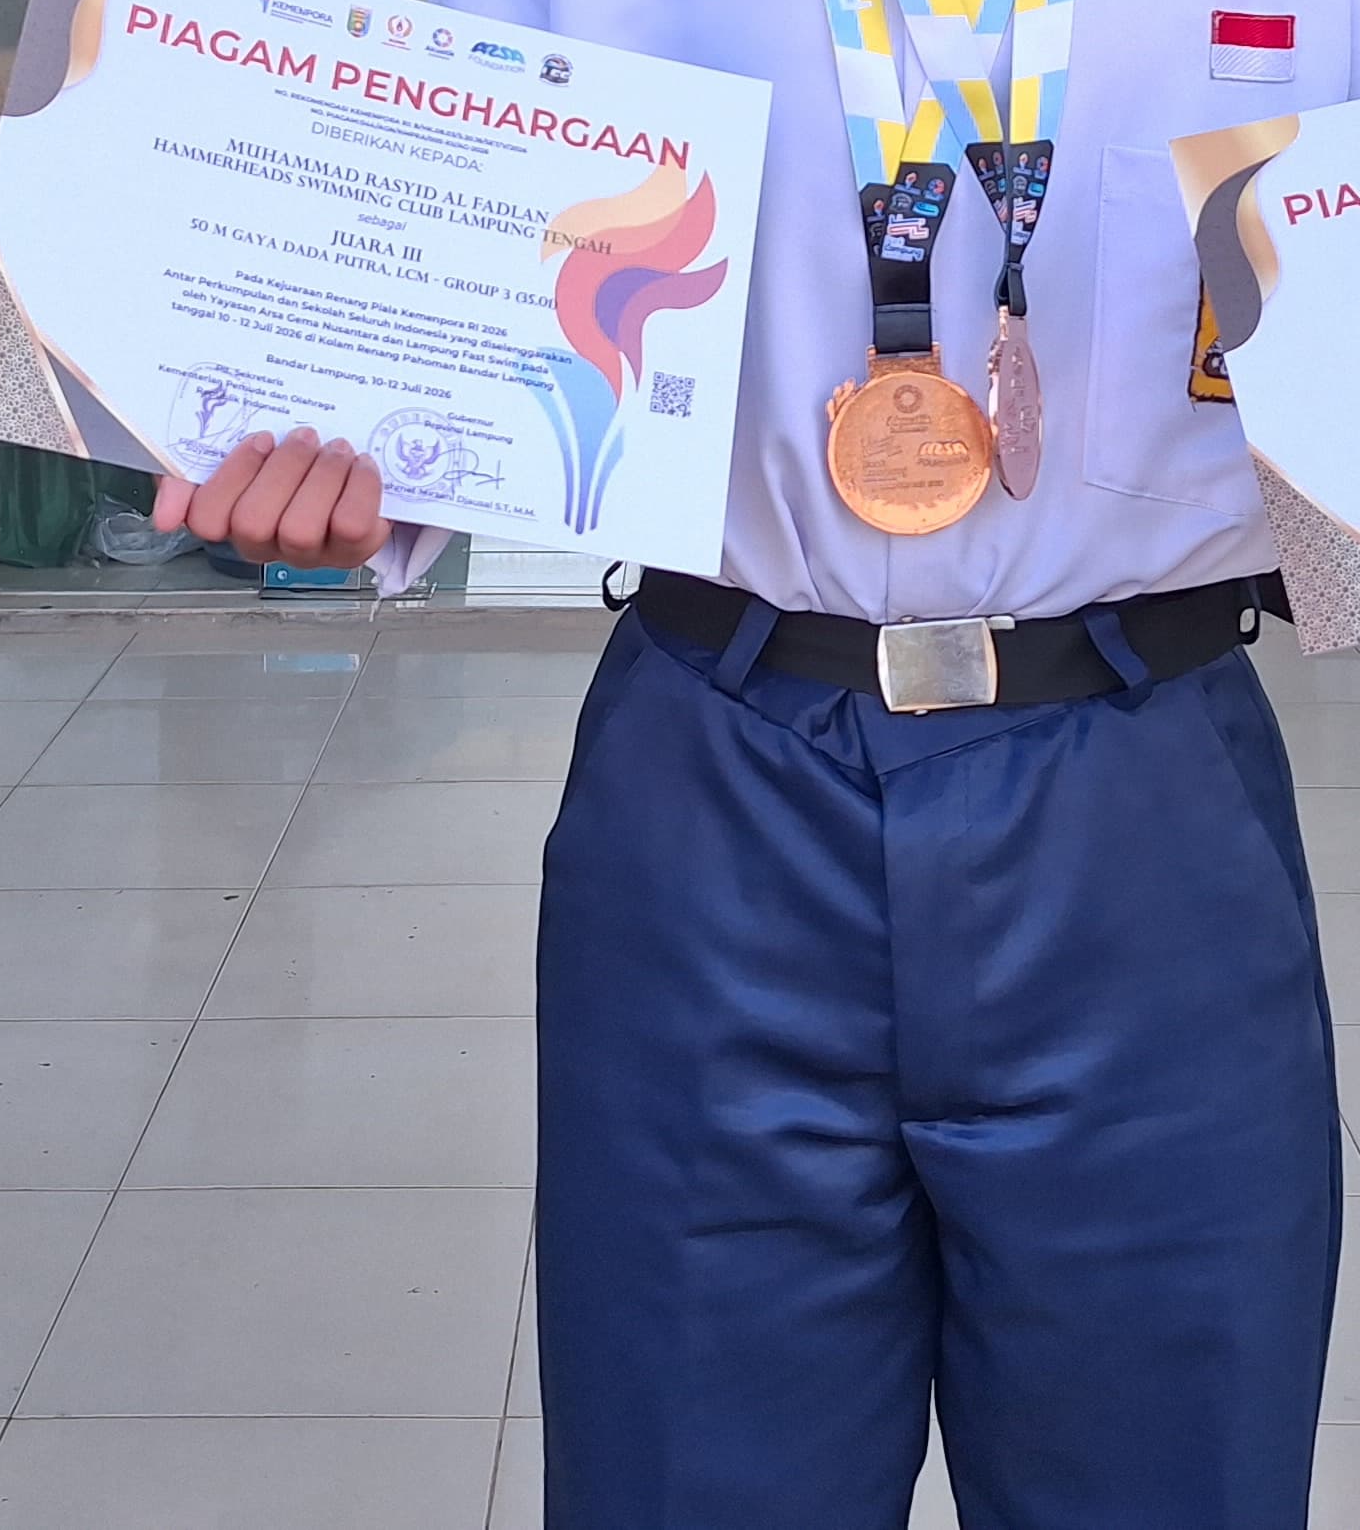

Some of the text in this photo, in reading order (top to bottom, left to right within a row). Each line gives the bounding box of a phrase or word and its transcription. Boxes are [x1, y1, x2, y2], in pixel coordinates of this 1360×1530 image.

[126, 4, 316, 82] PIAGAM
[331, 60, 691, 170] PENGHARGAAN
[226, 138, 549, 227] MUHAMMAD RASYID AL FADLAN
[311, 121, 404, 154] DIBERIKAN
[409, 145, 483, 172] KEPADA:
[153, 137, 613, 256] HAMMERHEADS SWIMMING CLUB LAMPUNG TENGAH
[357, 213, 407, 230] sebagai
[190, 218, 208, 231] 50
[212, 223, 226, 236] M
[232, 228, 276, 249] GAYA
[282, 240, 328, 261] DADA
[334, 253, 390, 276] PUTRA,
[396, 266, 428, 283] LCM
[444, 277, 498, 296] GROUP
[503, 288, 510, 299] 3
[330, 230, 421, 261] JUARA III
